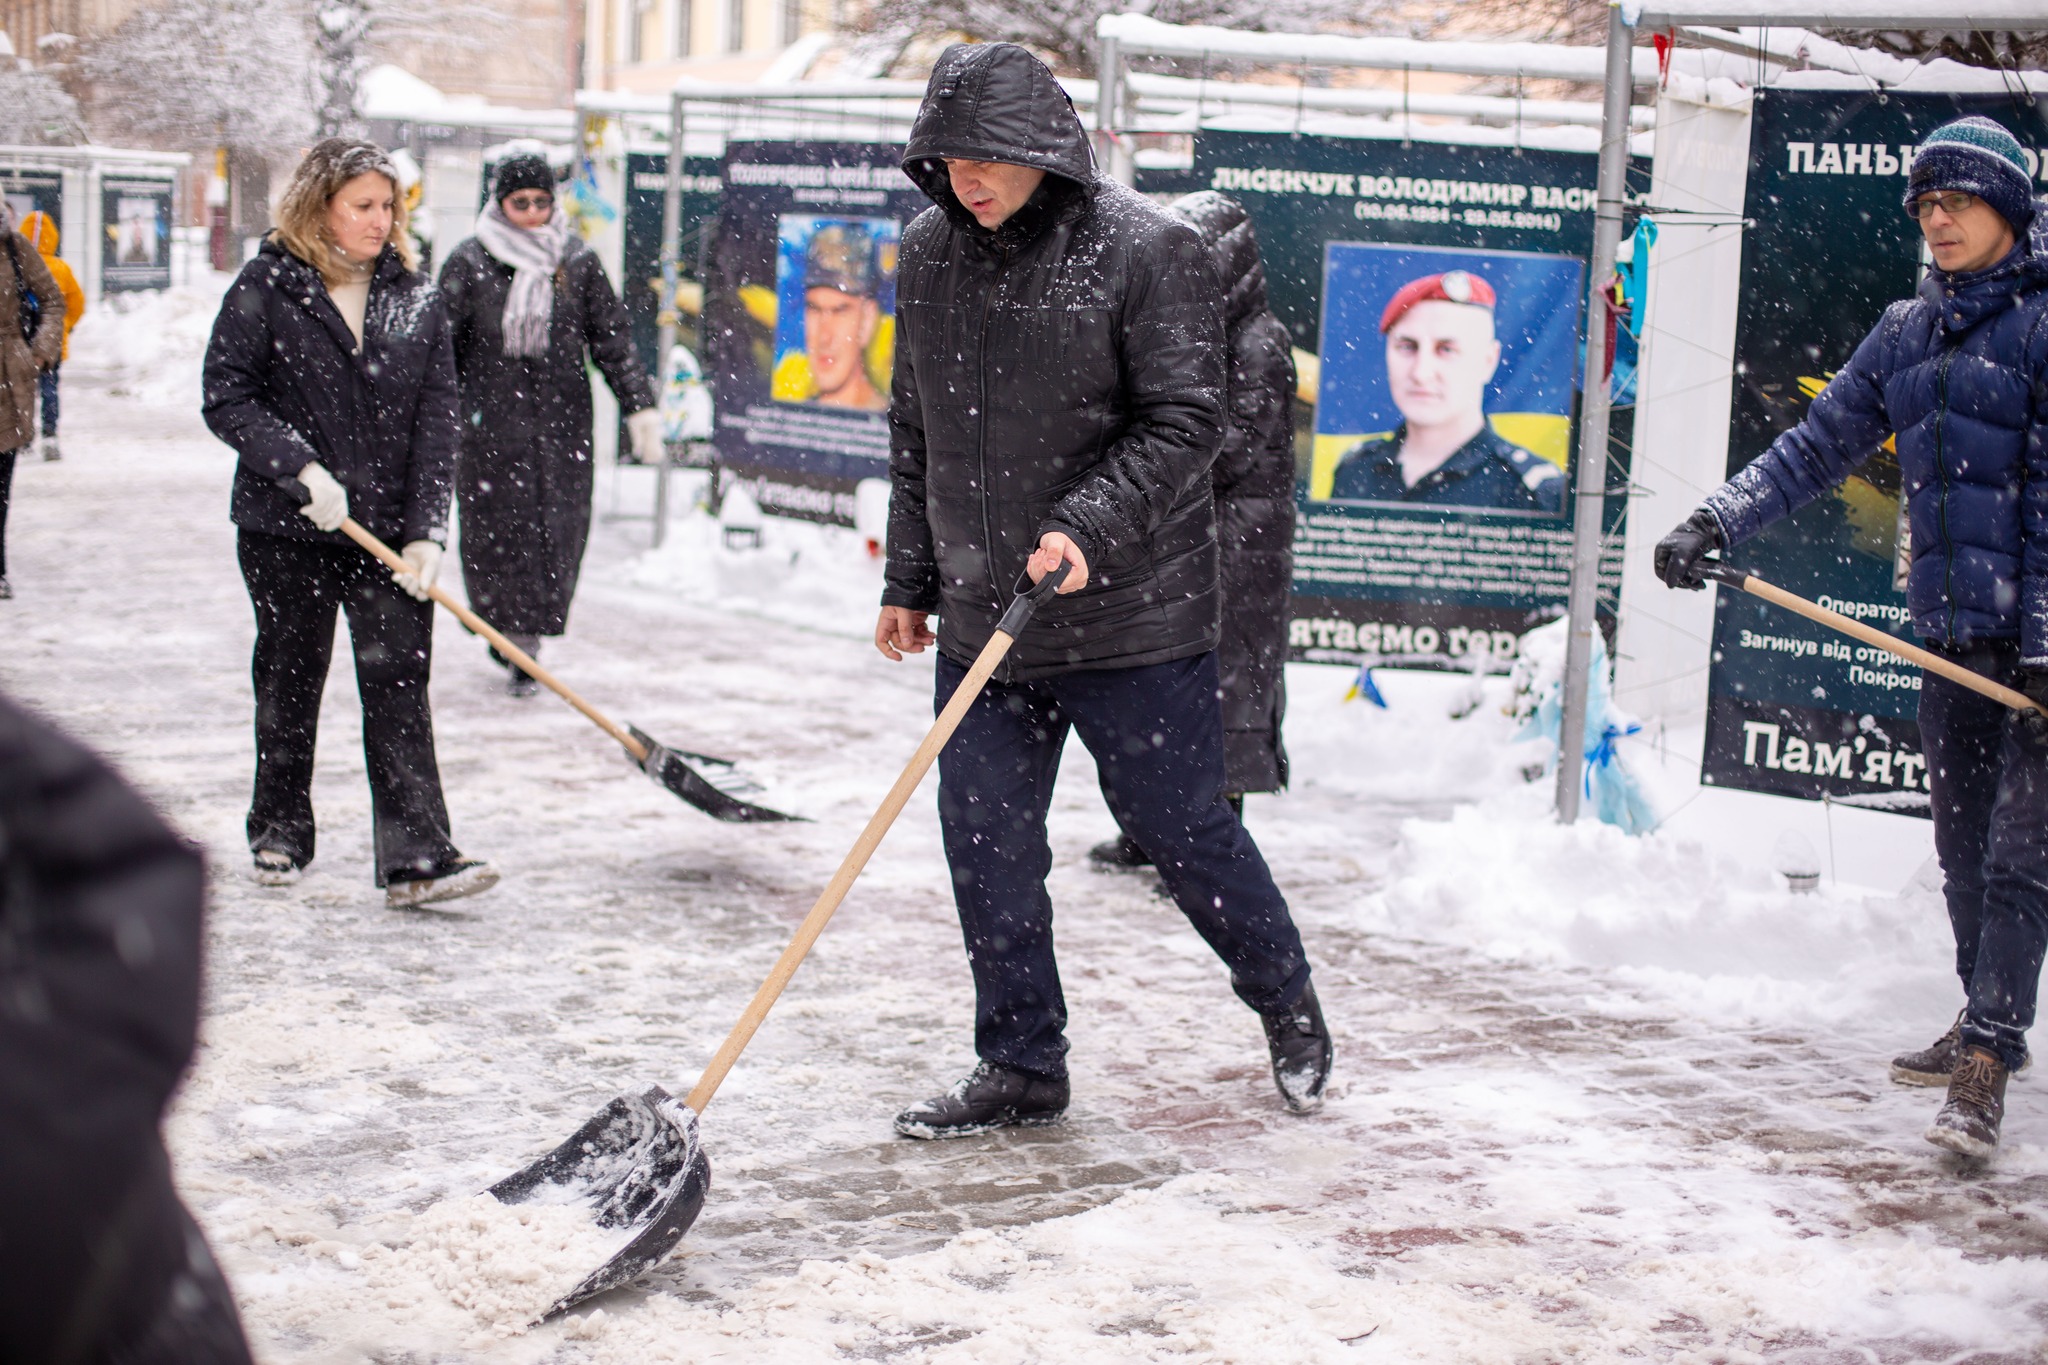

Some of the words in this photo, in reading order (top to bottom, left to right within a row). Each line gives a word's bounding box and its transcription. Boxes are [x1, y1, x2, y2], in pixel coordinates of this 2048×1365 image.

[1211, 166, 1355, 196] ЛИСЕНЧУК
[1357, 175, 1527, 206] ВОЛОДИМИР
[1817, 595, 1911, 625] Оператор
[1448, 626, 1523, 658] гер
[1740, 629, 1817, 657] Загинув
[1822, 639, 1852, 662] від
[1850, 665, 1922, 690] Покров
[1743, 720, 1931, 790] Пам’ят
